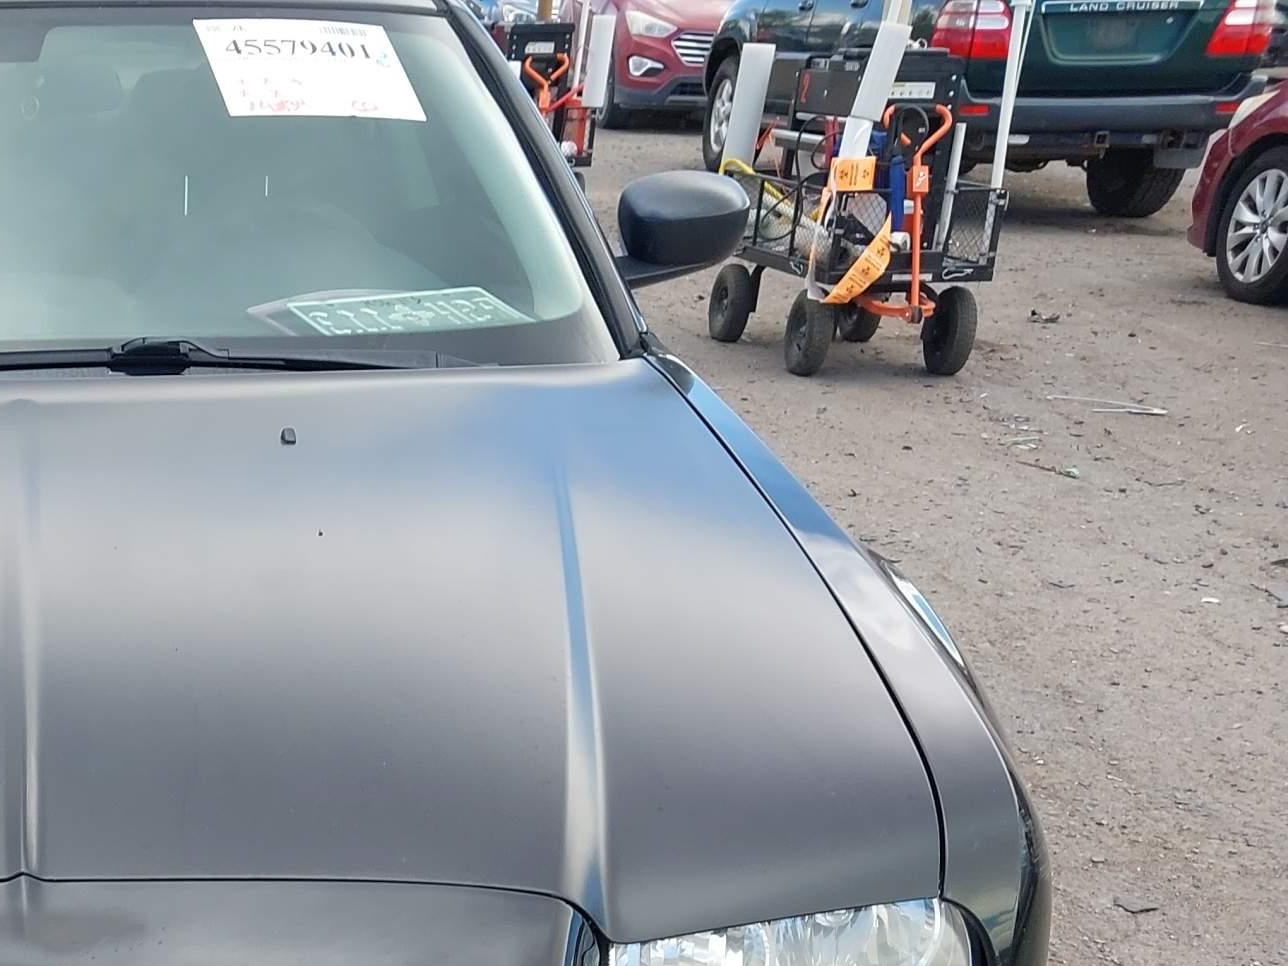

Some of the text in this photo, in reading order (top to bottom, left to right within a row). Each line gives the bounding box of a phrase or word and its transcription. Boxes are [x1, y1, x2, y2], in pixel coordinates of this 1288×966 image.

[1069, 0, 1179, 12] LAND CRUISER
[225, 39, 371, 59] 45579401
